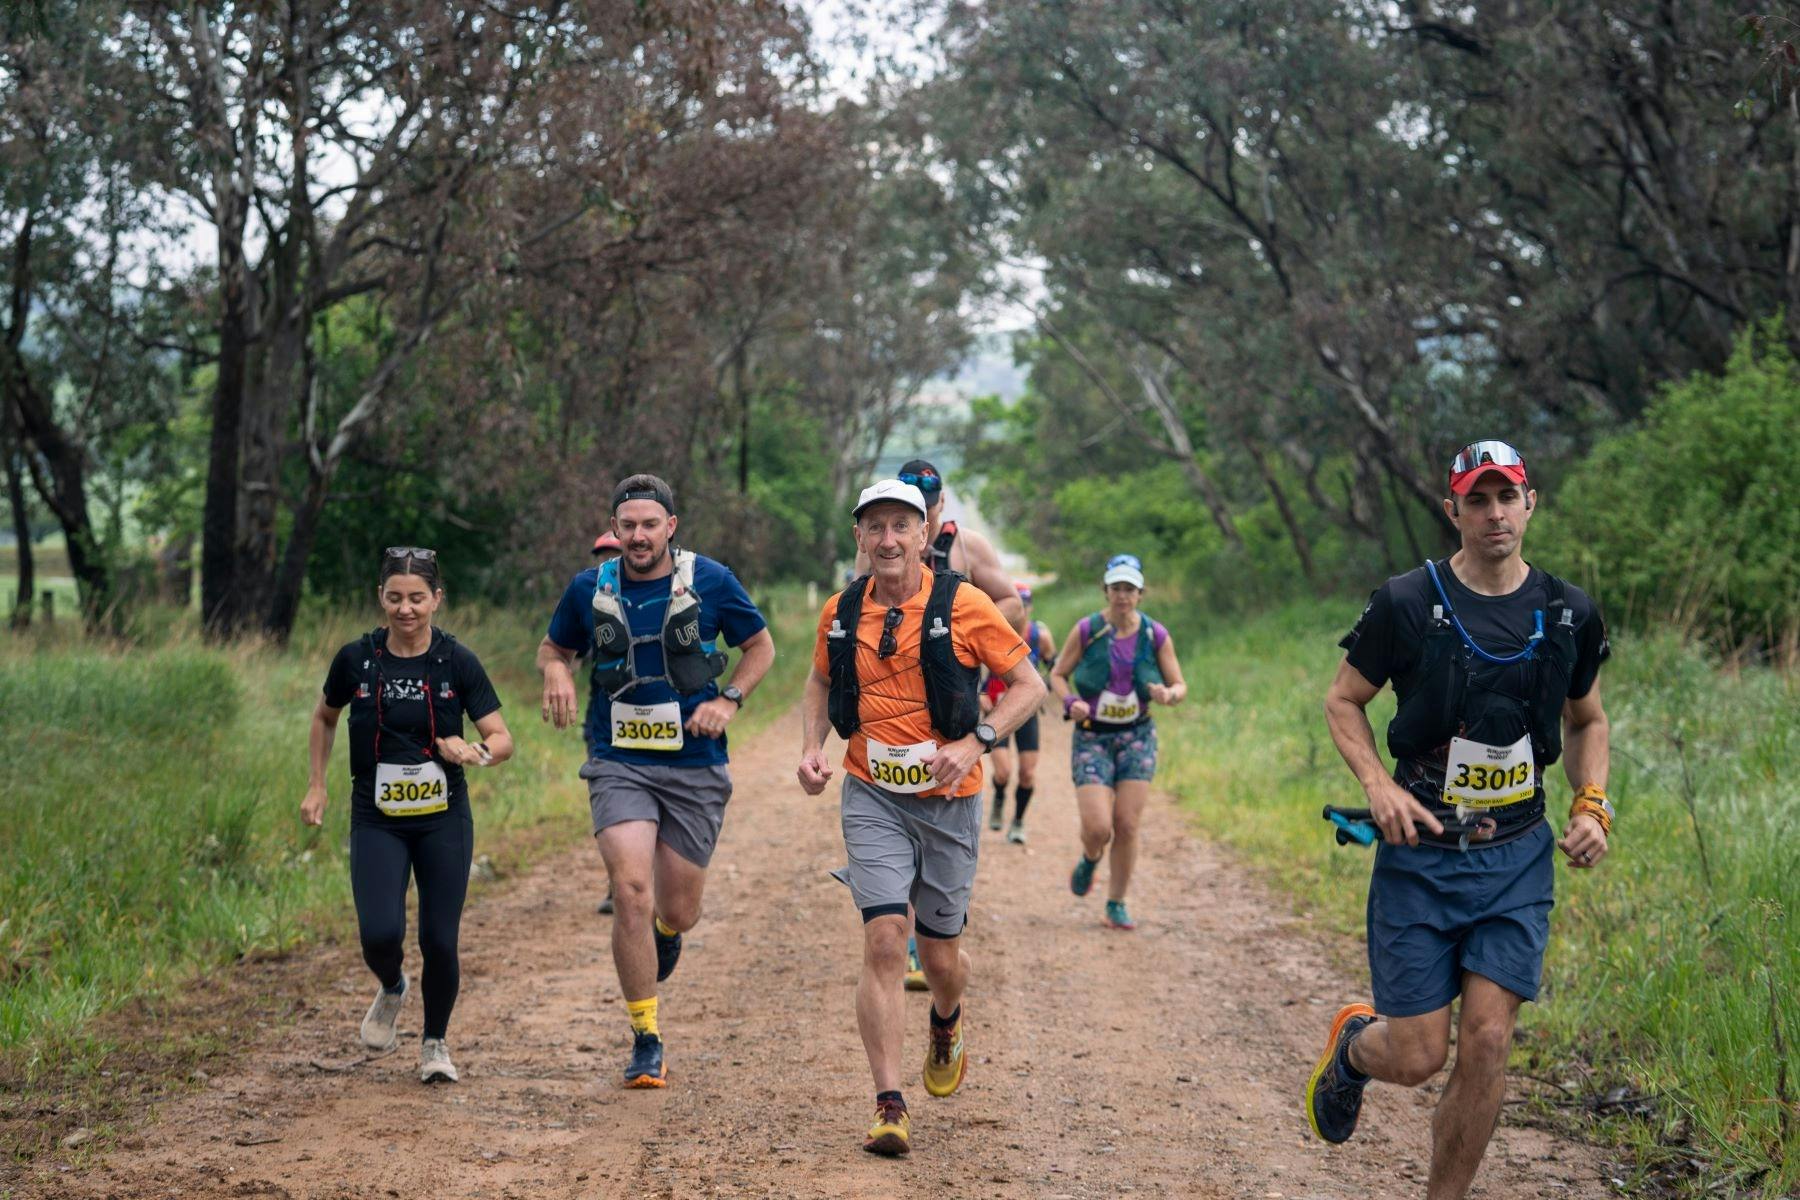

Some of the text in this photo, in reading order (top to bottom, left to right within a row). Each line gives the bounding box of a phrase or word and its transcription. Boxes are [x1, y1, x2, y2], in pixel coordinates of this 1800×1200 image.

[616, 720, 678, 740] 33025
[871, 759, 933, 786] 33009
[1454, 762, 1528, 791] 33013
[380, 779, 443, 802] 33024
